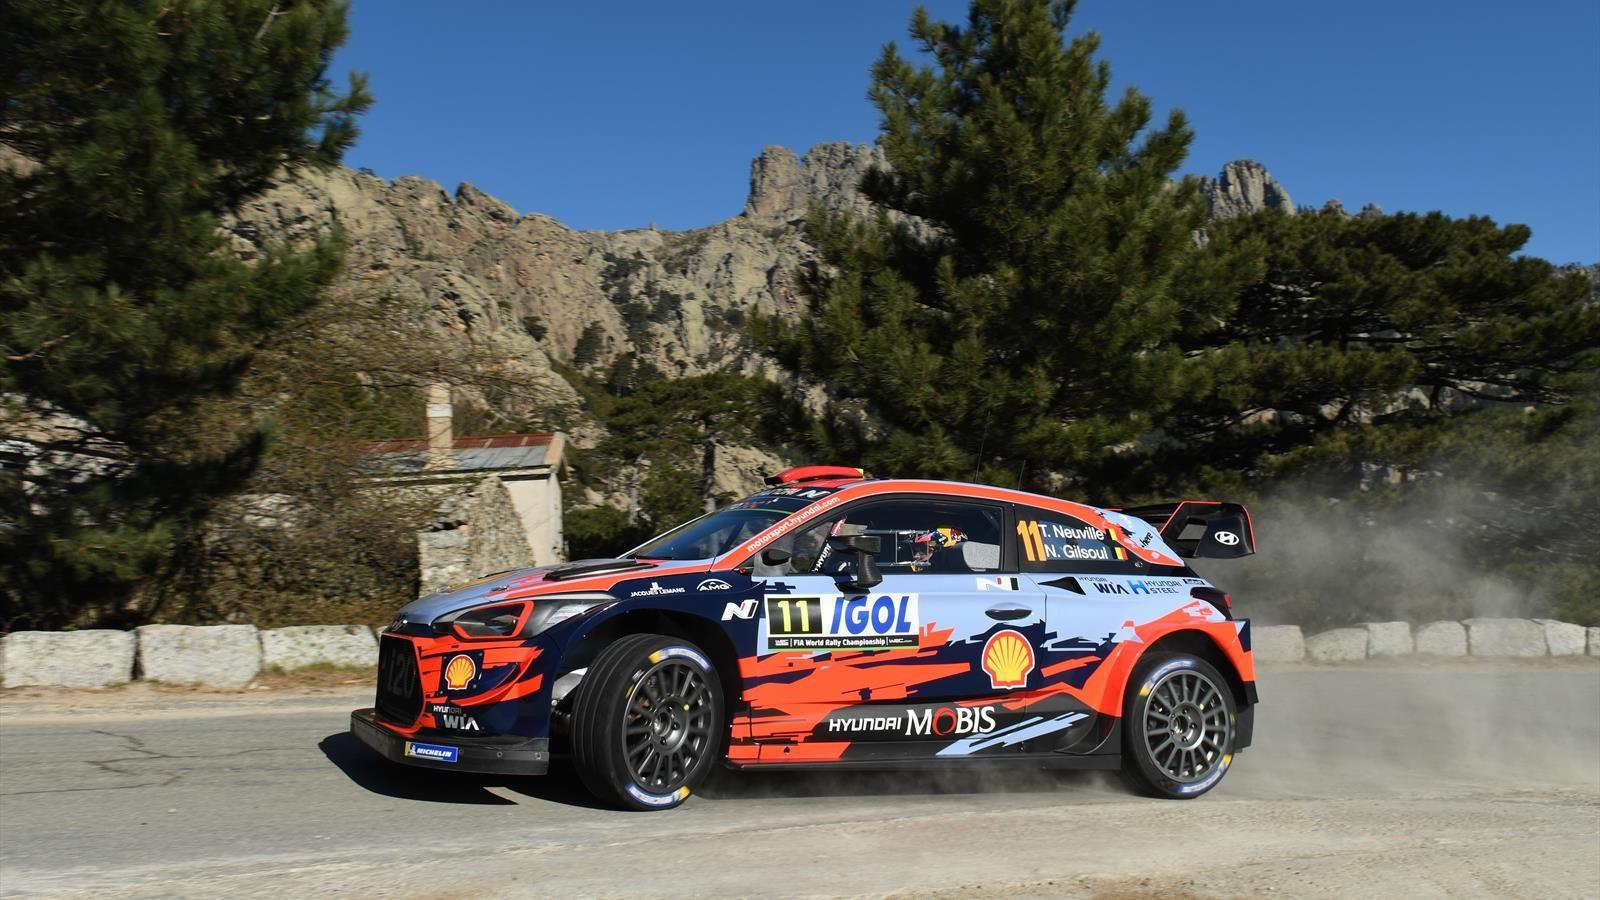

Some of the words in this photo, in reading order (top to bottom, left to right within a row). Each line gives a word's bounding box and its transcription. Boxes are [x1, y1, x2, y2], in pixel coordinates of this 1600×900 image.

[746, 496, 840, 553] motorsport.hyundai.com
[1037, 523, 1051, 538] T.
[1053, 525, 1105, 541] Neuville
[1016, 519, 1047, 562] 11
[1045, 544, 1060, 558] N.
[1063, 544, 1109, 560] Gilsoul
[630, 589, 659, 598] JACQUES
[659, 586, 686, 595] LEMANS
[700, 584, 730, 592] AMG
[1093, 581, 1130, 595] WIA
[777, 600, 810, 632] 11
[829, 595, 912, 635] IGOL
[825, 638, 842, 647] Rally
[843, 637, 886, 647] Championship
[433, 705, 462, 714] HYUNDAI
[828, 717, 902, 732] HYUNDAI
[905, 706, 996, 737] MOBIS
[416, 747, 452, 758] MICHELIN
